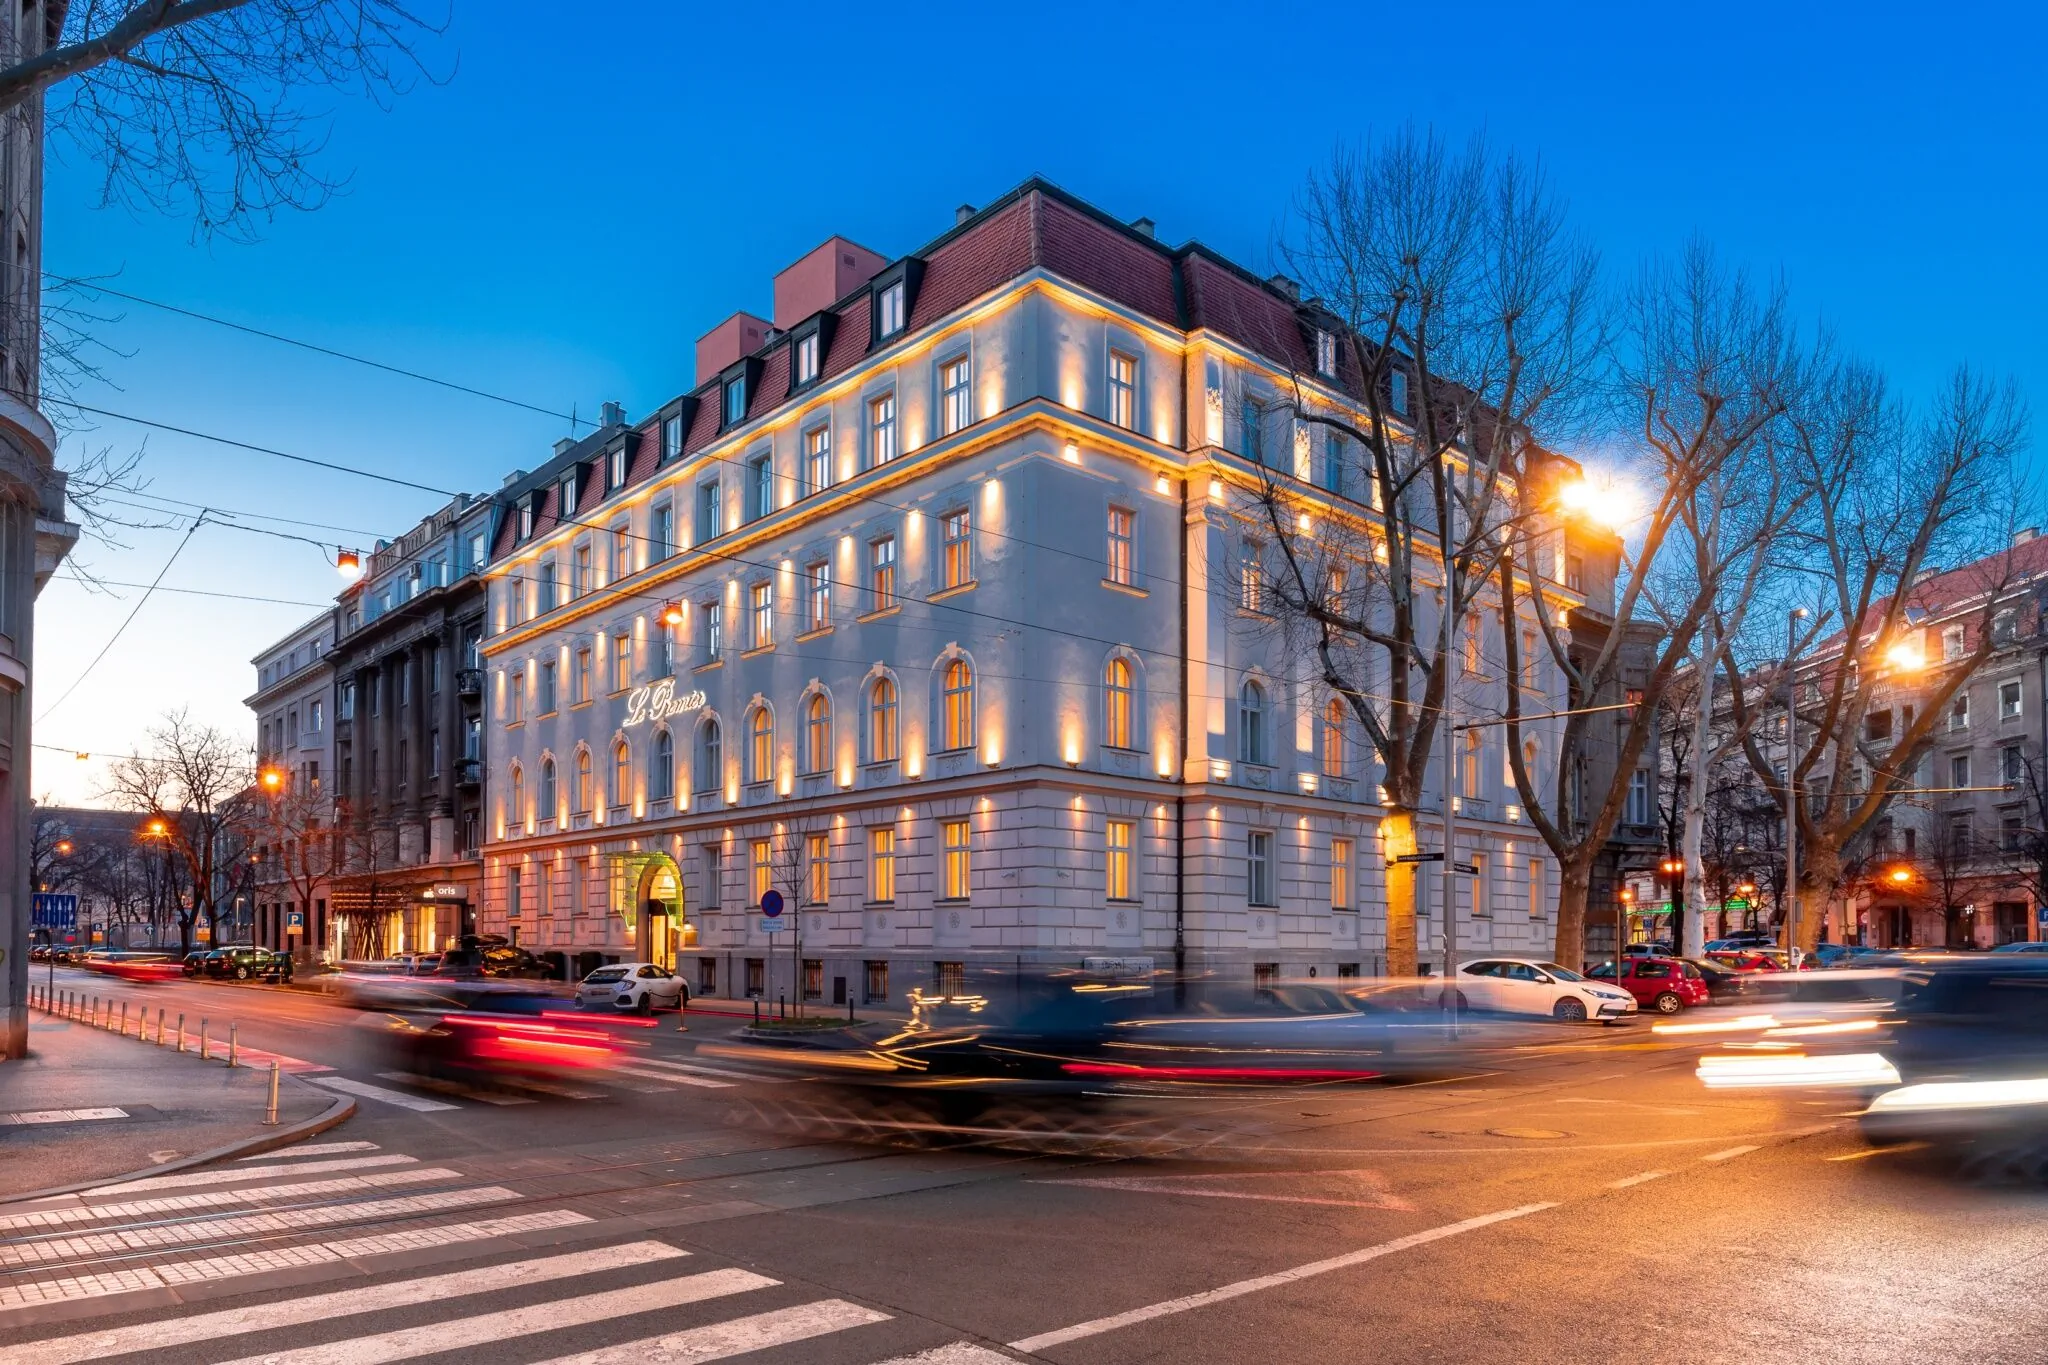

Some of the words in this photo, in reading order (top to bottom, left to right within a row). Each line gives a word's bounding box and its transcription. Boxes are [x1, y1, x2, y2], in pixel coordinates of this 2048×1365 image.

[622, 687, 650, 727] Le
[649, 680, 706, 720] Premier
[438, 886, 456, 895] oris
[291, 915, 299, 924] P
